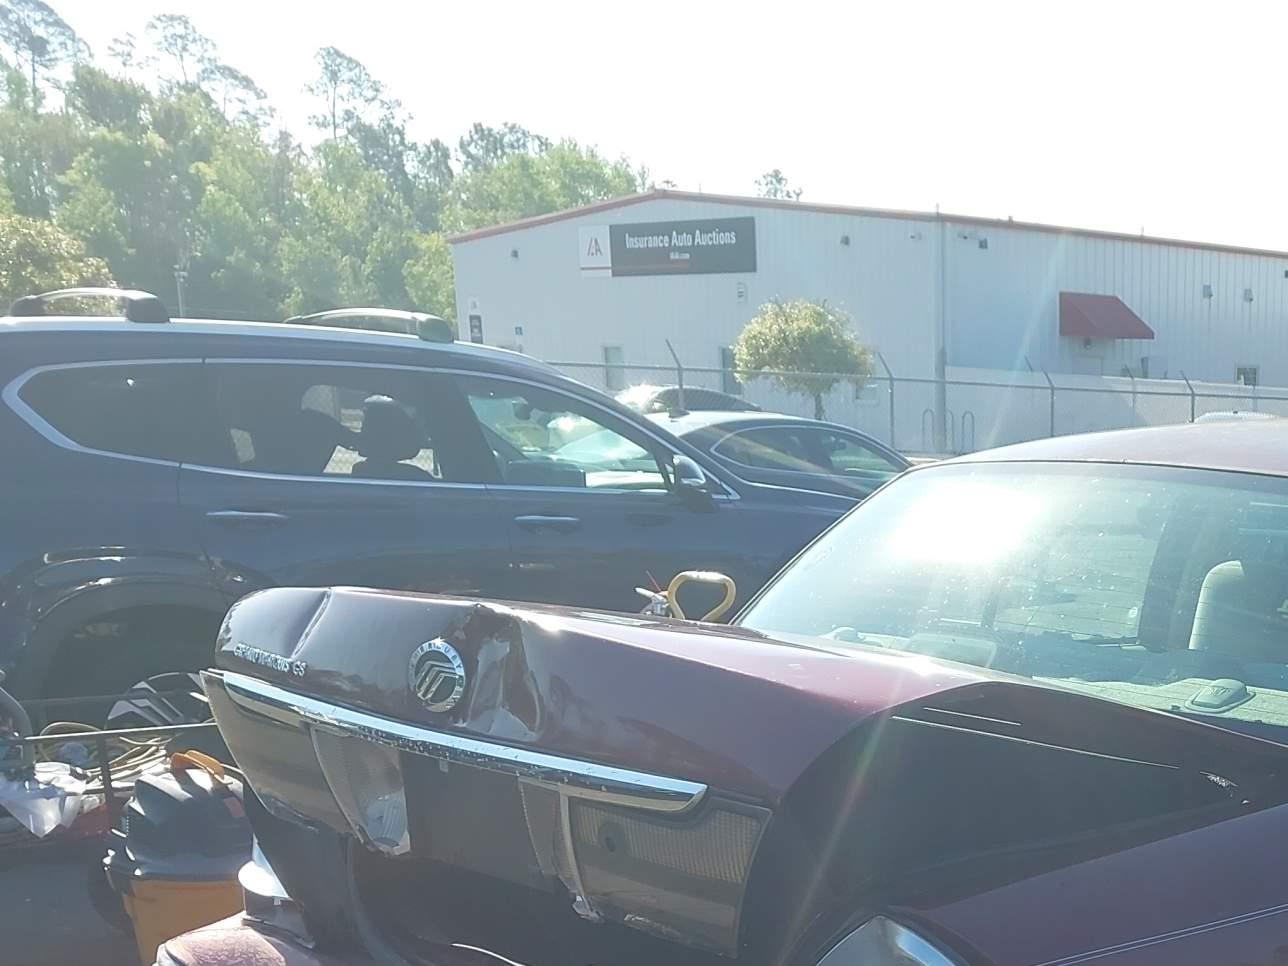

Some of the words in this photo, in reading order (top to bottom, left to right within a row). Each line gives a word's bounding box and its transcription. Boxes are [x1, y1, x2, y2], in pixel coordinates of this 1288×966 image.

[625, 232, 670, 249] Insurance
[671, 230, 692, 247] Auto
[694, 228, 736, 246] Auctions
